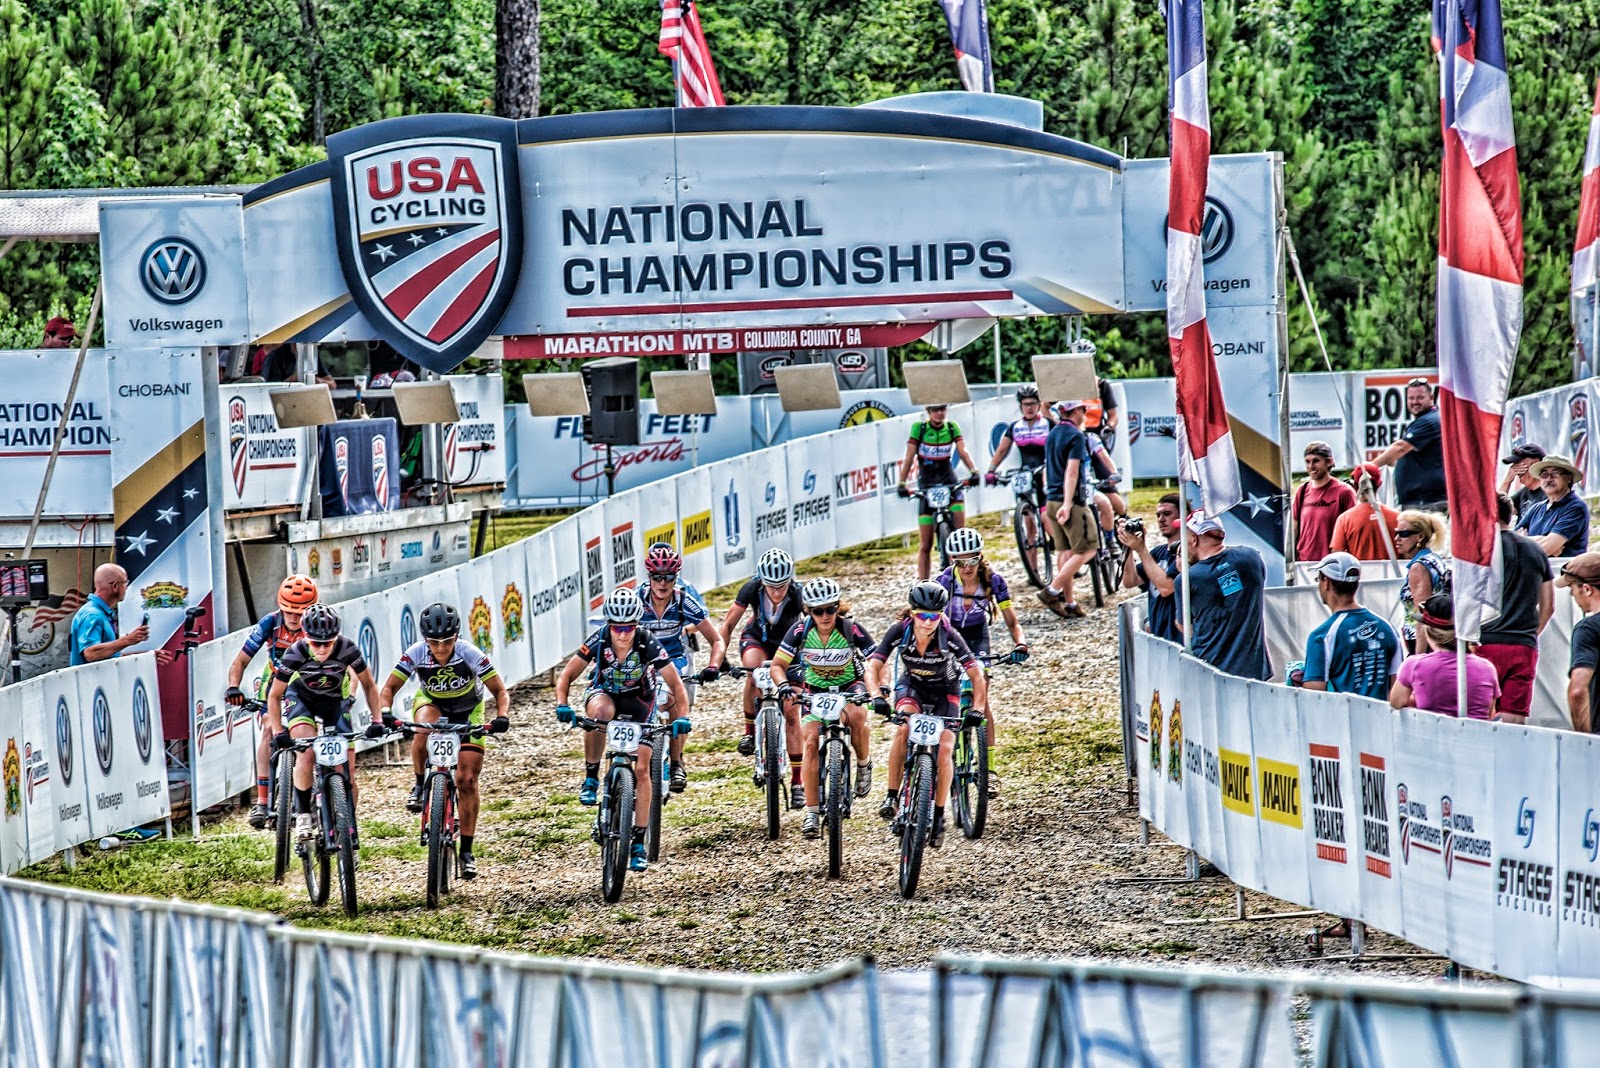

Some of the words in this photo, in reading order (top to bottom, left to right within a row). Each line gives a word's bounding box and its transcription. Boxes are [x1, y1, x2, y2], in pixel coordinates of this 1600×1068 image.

[366, 156, 485, 201] USA
[370, 198, 486, 225] CYCLING
[562, 199, 823, 246] NATIONAL
[563, 240, 1012, 296] CHAMPIONSHIPS
[1151, 278, 1250, 293] Vwagen
[129, 318, 223, 333] Volkswagen
[544, 334, 675, 355] MARATHON
[682, 330, 734, 351] MTB
[744, 330, 798, 349] COLUMBIA
[800, 328, 844, 348] COUNTY,
[846, 328, 862, 345] GA
[1212, 341, 1264, 356] OBANI
[119, 383, 191, 398] CHOBANI
[0, 402, 102, 422] ATIONAL
[248, 414, 277, 434] NATIONAL
[646, 413, 716, 435] FEET
[1144, 416, 1176, 425] NATION
[249, 438, 297, 459] CHAMPIONSHIPS
[571, 437, 698, 482] Sports
[835, 471, 851, 498] KT
[850, 465, 878, 494] TAPE
[882, 462, 896, 487] KT
[756, 507, 787, 534] STAGES
[793, 495, 831, 522] STAGES
[685, 517, 711, 547] MAVIC
[612, 530, 635, 565] BONK
[759, 671, 772, 682] 26
[817, 697, 838, 711] 267
[613, 726, 635, 741] 259
[914, 719, 936, 736] 269
[320, 742, 341, 755] 260
[433, 740, 453, 756] 258
[136, 779, 162, 798] Volkswagen
[1221, 760, 1250, 803] MAVIC
[1263, 771, 1298, 816] MAVIC
[1310, 757, 1343, 809] BONK
[95, 791, 124, 811] Volkswagen
[1360, 767, 1388, 822] BONK
[1313, 807, 1346, 844] BREAKER
[1453, 813, 1475, 833] NATIONAL
[1364, 818, 1391, 857] BREAKER
[1454, 834, 1492, 858] CHAMPIONSHIPS
[1499, 858, 1553, 902] STAGES
[1564, 871, 1600, 914] STAG
[1497, 894, 1552, 917] CYCLING
[1563, 908, 1600, 929] CYCL
